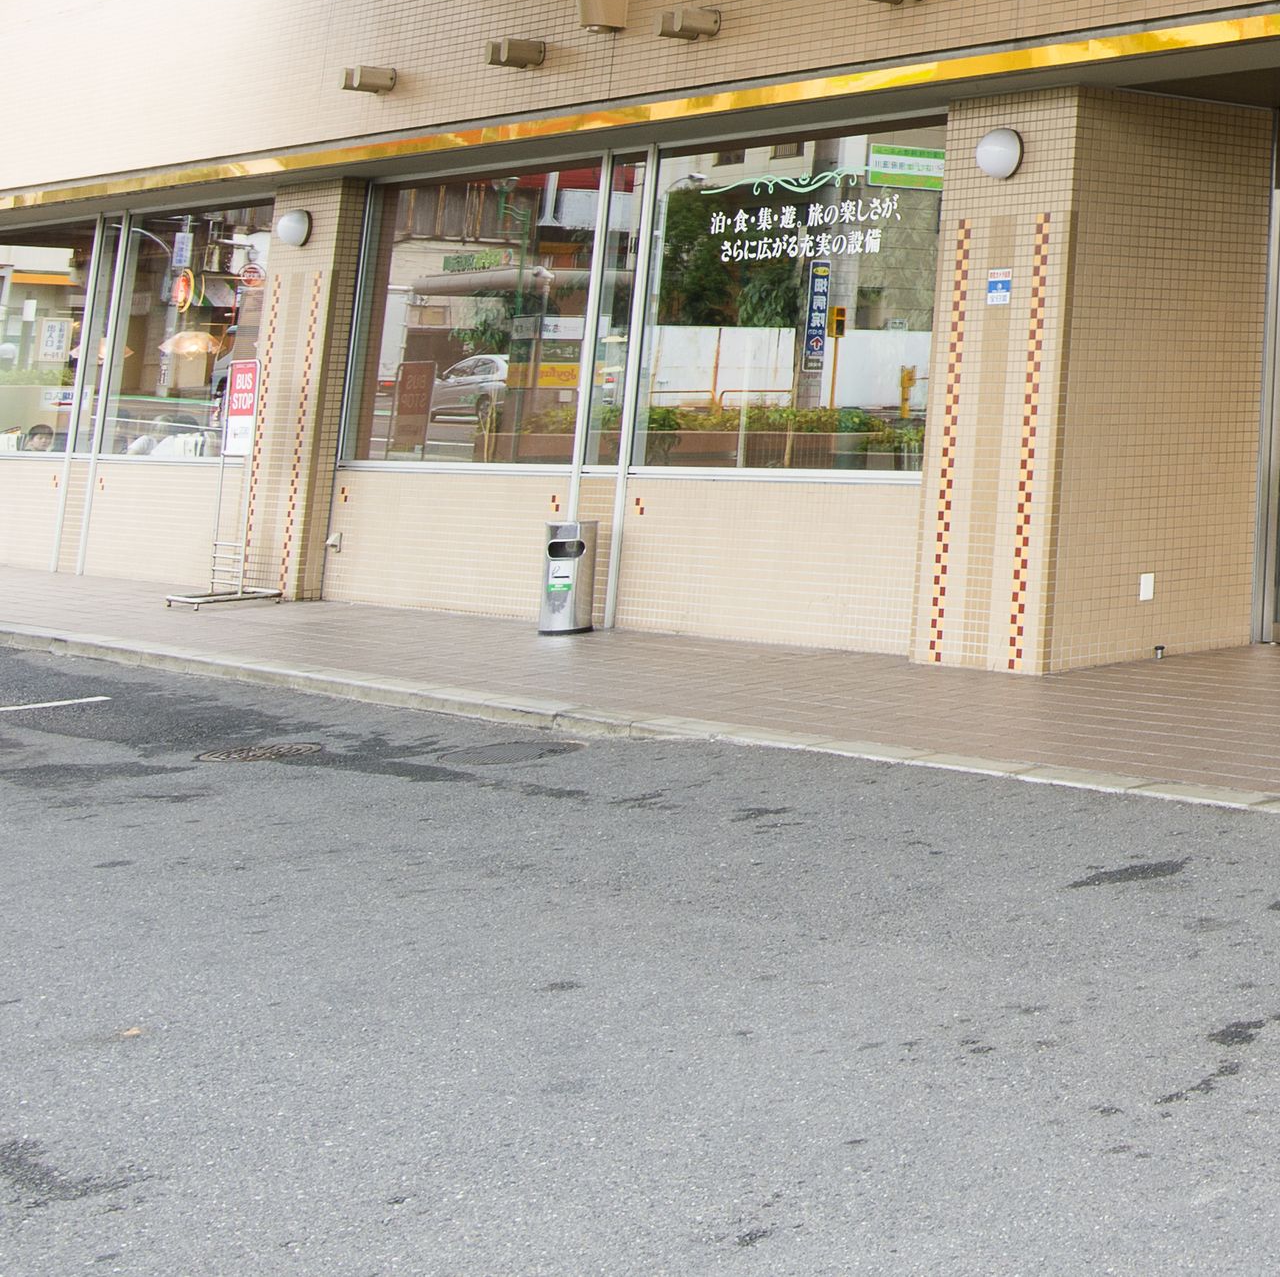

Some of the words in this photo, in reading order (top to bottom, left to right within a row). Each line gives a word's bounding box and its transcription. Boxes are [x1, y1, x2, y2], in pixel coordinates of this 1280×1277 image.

[721, 229, 882, 262] さらに広がる充実の設備
[235, 373, 253, 390] BUS
[232, 392, 254, 410] STOP
